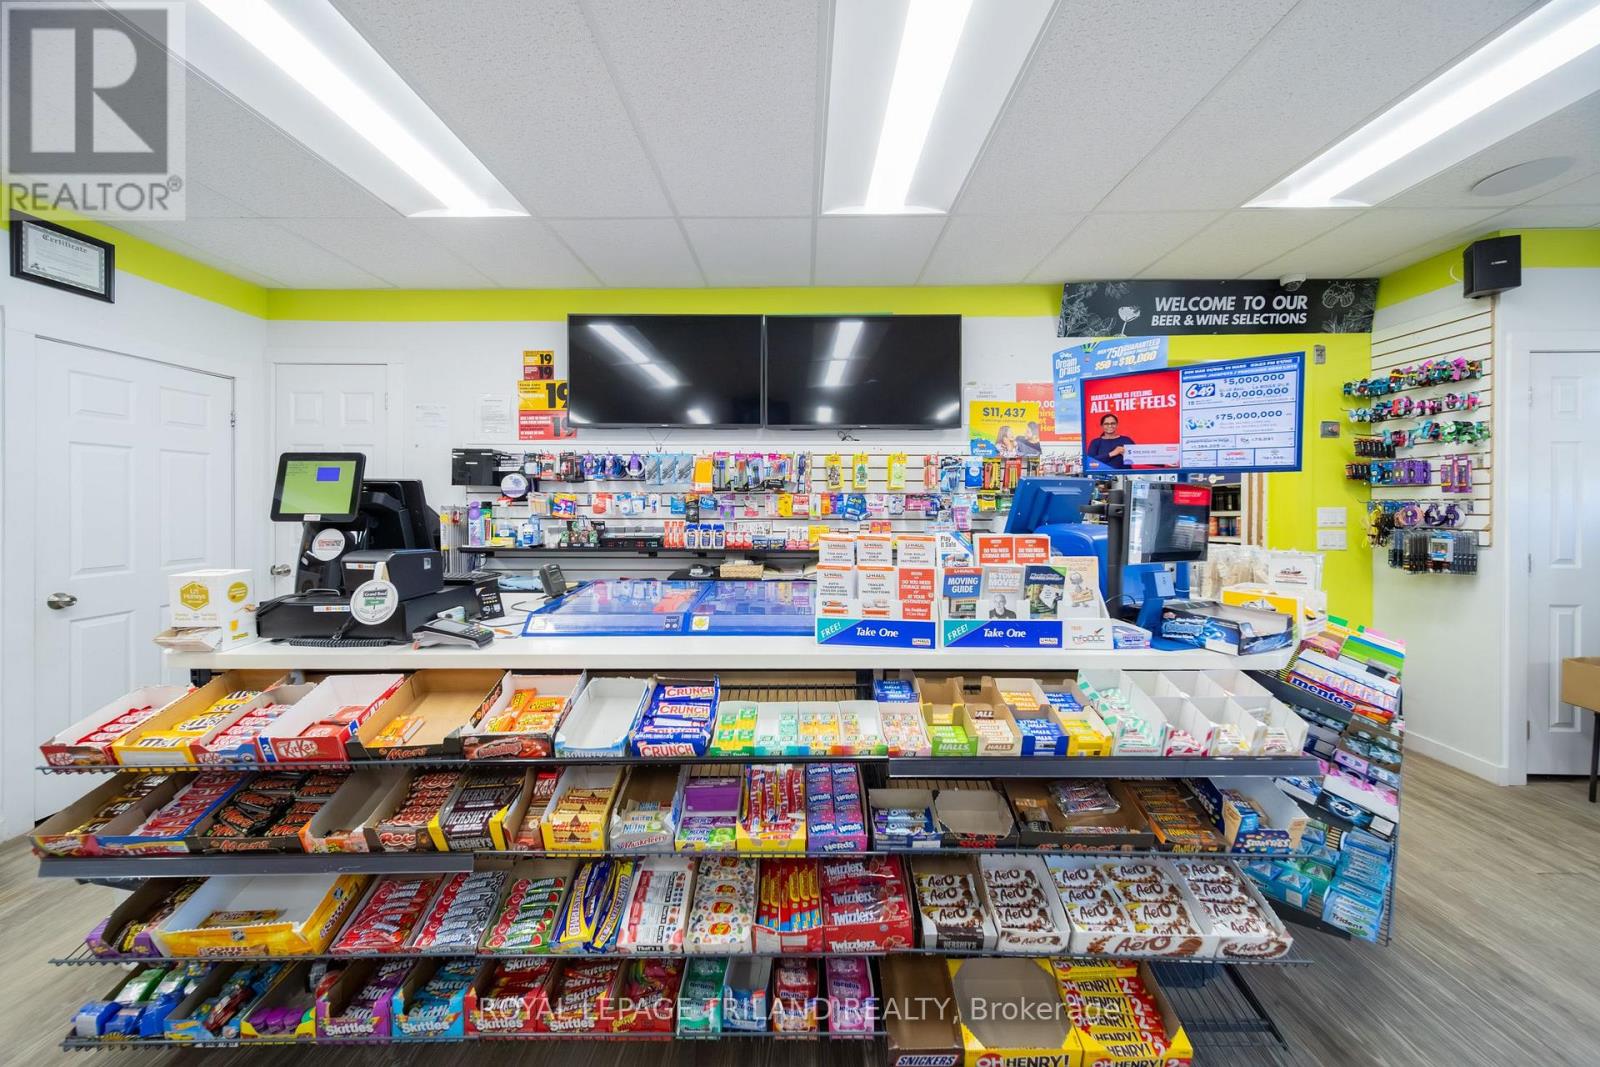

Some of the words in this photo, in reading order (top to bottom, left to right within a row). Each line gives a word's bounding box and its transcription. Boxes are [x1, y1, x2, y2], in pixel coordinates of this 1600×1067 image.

[42, 232, 88, 254] Certificate
[1155, 295, 1236, 312] WELCOME
[1243, 295, 1266, 311] TO
[1272, 295, 1309, 311] OUR
[1151, 315, 1181, 327] BEER
[1183, 315, 1194, 326] &
[1195, 313, 1229, 326] WINE
[1231, 312, 1307, 326] SELECTIONS
[539, 353, 552, 365] 19
[1106, 347, 1123, 359] 750
[1118, 350, 1158, 367] $10,000
[1055, 358, 1078, 370] Dream
[539, 366, 553, 379] 19
[1223, 373, 1285, 385] $5,000,000
[1219, 386, 1289, 399] $40,000,000
[1090, 400, 1111, 414] ALL
[1114, 398, 1137, 412] THE
[1140, 394, 1176, 410] FEELS
[982, 407, 1026, 418] $11,437
[1215, 410, 1283, 421] $75,000,000
[948, 576, 978, 586] MOVING
[952, 585, 974, 594] GUIDE
[820, 622, 842, 638] FREE!
[856, 627, 876, 636] Take
[879, 628, 899, 638] One
[947, 624, 969, 640] FREE!
[984, 628, 1004, 638] Take
[1006, 628, 1027, 638] One
[666, 686, 714, 696] CRUNCH
[1291, 676, 1355, 710] mentos
[659, 705, 709, 715] CRUNCH
[641, 744, 693, 757] CRUNCH
[938, 743, 970, 751] HALLS
[986, 743, 1013, 751] HALLS
[808, 766, 829, 774] Nerds
[834, 766, 855, 774] Nerds
[809, 794, 831, 802] Nerds
[836, 794, 858, 802] Nerds
[446, 809, 499, 824] HERSHEY'S
[811, 824, 834, 832] Nerds
[838, 824, 862, 833] Nerds
[380, 832, 416, 846] Rolo
[450, 838, 494, 849] HERSHEY'S
[623, 836, 668, 849] Musketeers
[824, 841, 855, 851] Nerds
[825, 862, 865, 876] Twizzlers
[1120, 865, 1147, 876] Aero
[1192, 864, 1218, 876] Aero
[928, 875, 955, 888] Aero
[994, 870, 1020, 882] Aero
[1062, 869, 1089, 883] Aero
[930, 888, 957, 902] Aero
[1000, 887, 1027, 901] Aero
[1068, 888, 1096, 902] Aero
[1136, 883, 1164, 897] Aero
[1204, 883, 1232, 896] Aero
[832, 892, 873, 904] Twizzlers
[940, 907, 967, 922] Aero
[1004, 907, 1032, 922] Aero
[1080, 905, 1108, 920] Aero
[1143, 903, 1172, 920] Aero
[832, 911, 874, 926] Twizzlers
[1332, 912, 1364, 930] Trident
[829, 940, 877, 952] Twizzlers
[1114, 936, 1171, 953] Aero
[1078, 978, 1118, 993] HENRY!
[1118, 978, 1132, 994] 2
[1064, 993, 1086, 1006] OH
[1131, 997, 1145, 1016] 2
[401, 1022, 451, 1034] Skittles
[476, 1018, 524, 1032] Skittles
[550, 1020, 596, 1032] Skittles
[1137, 1016, 1150, 1030] 2
[326, 1024, 374, 1036] Skittles
[898, 1055, 956, 1066] SNICKERS
[976, 1057, 1004, 1067] OH
[1006, 1055, 1070, 1067] HENRY!
[1116, 1058, 1164, 1067] HENRY!
